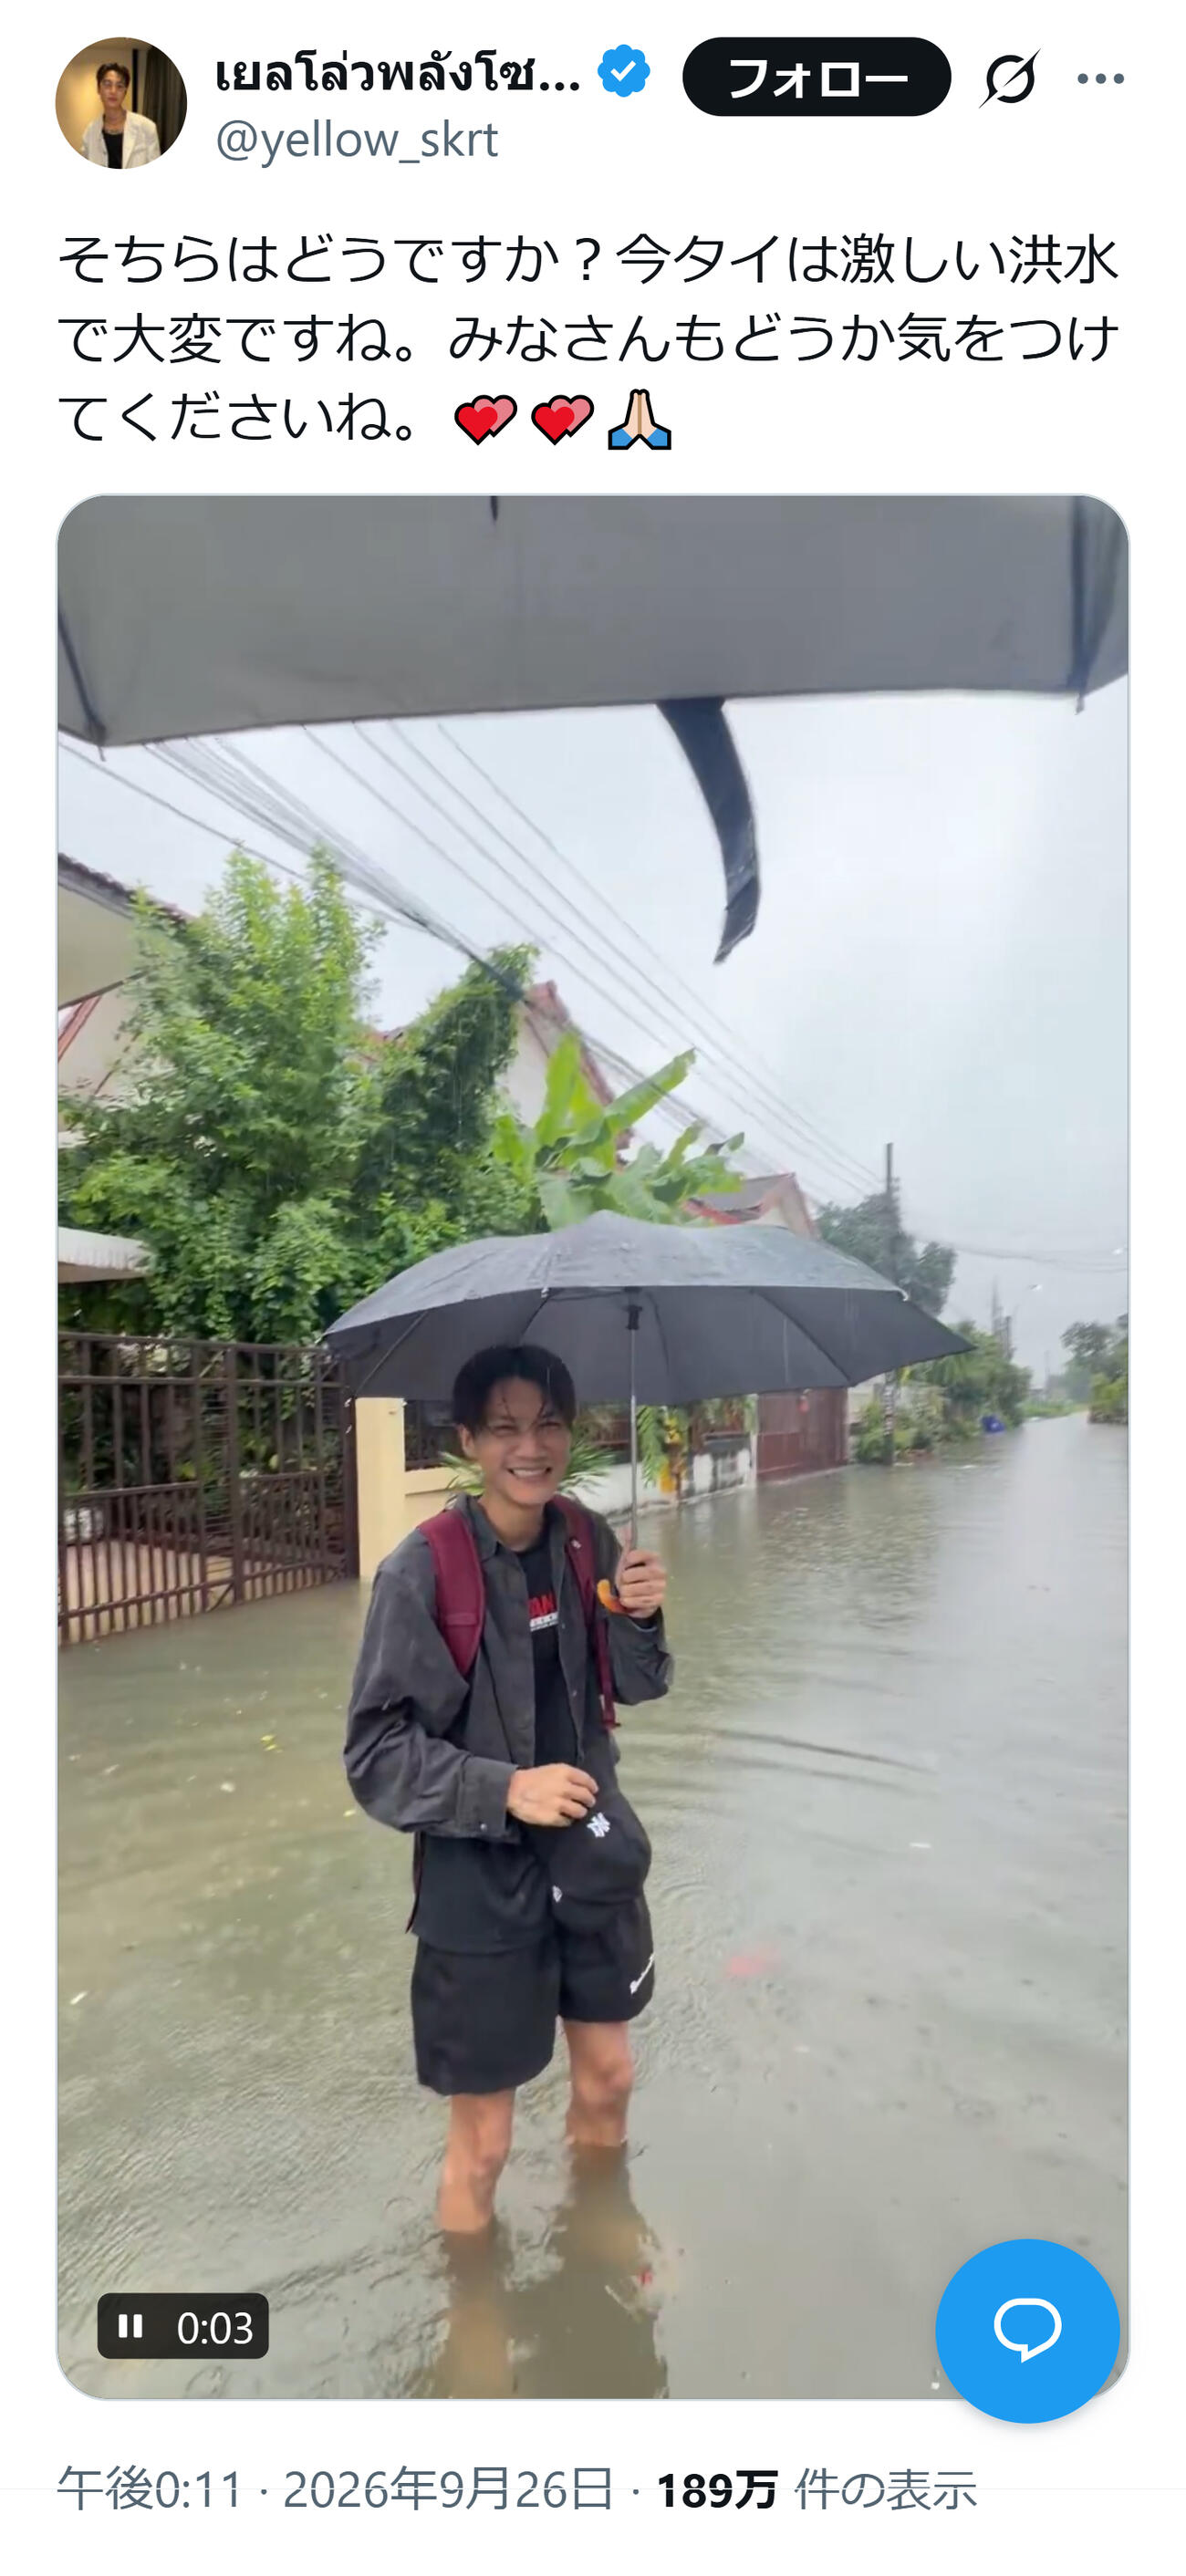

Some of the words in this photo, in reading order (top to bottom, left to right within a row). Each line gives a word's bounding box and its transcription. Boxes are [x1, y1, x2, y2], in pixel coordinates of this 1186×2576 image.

[729, 58, 910, 99] フォロー
[216, 118, 499, 170] @yellow_skrt
[58, 232, 1119, 286] そちらはどうですか？今タイは激しい洪水
[57, 310, 1120, 365] で大変ですね。みなさんもどうか気をつけ
[57, 389, 413, 443] てくださいね。
[56, 2463, 239, 2512] 午後0:11
[284, 2464, 611, 2512] 2026年9月26日
[657, 2468, 780, 2511] 189万
[793, 2467, 978, 2512] 件の表示
